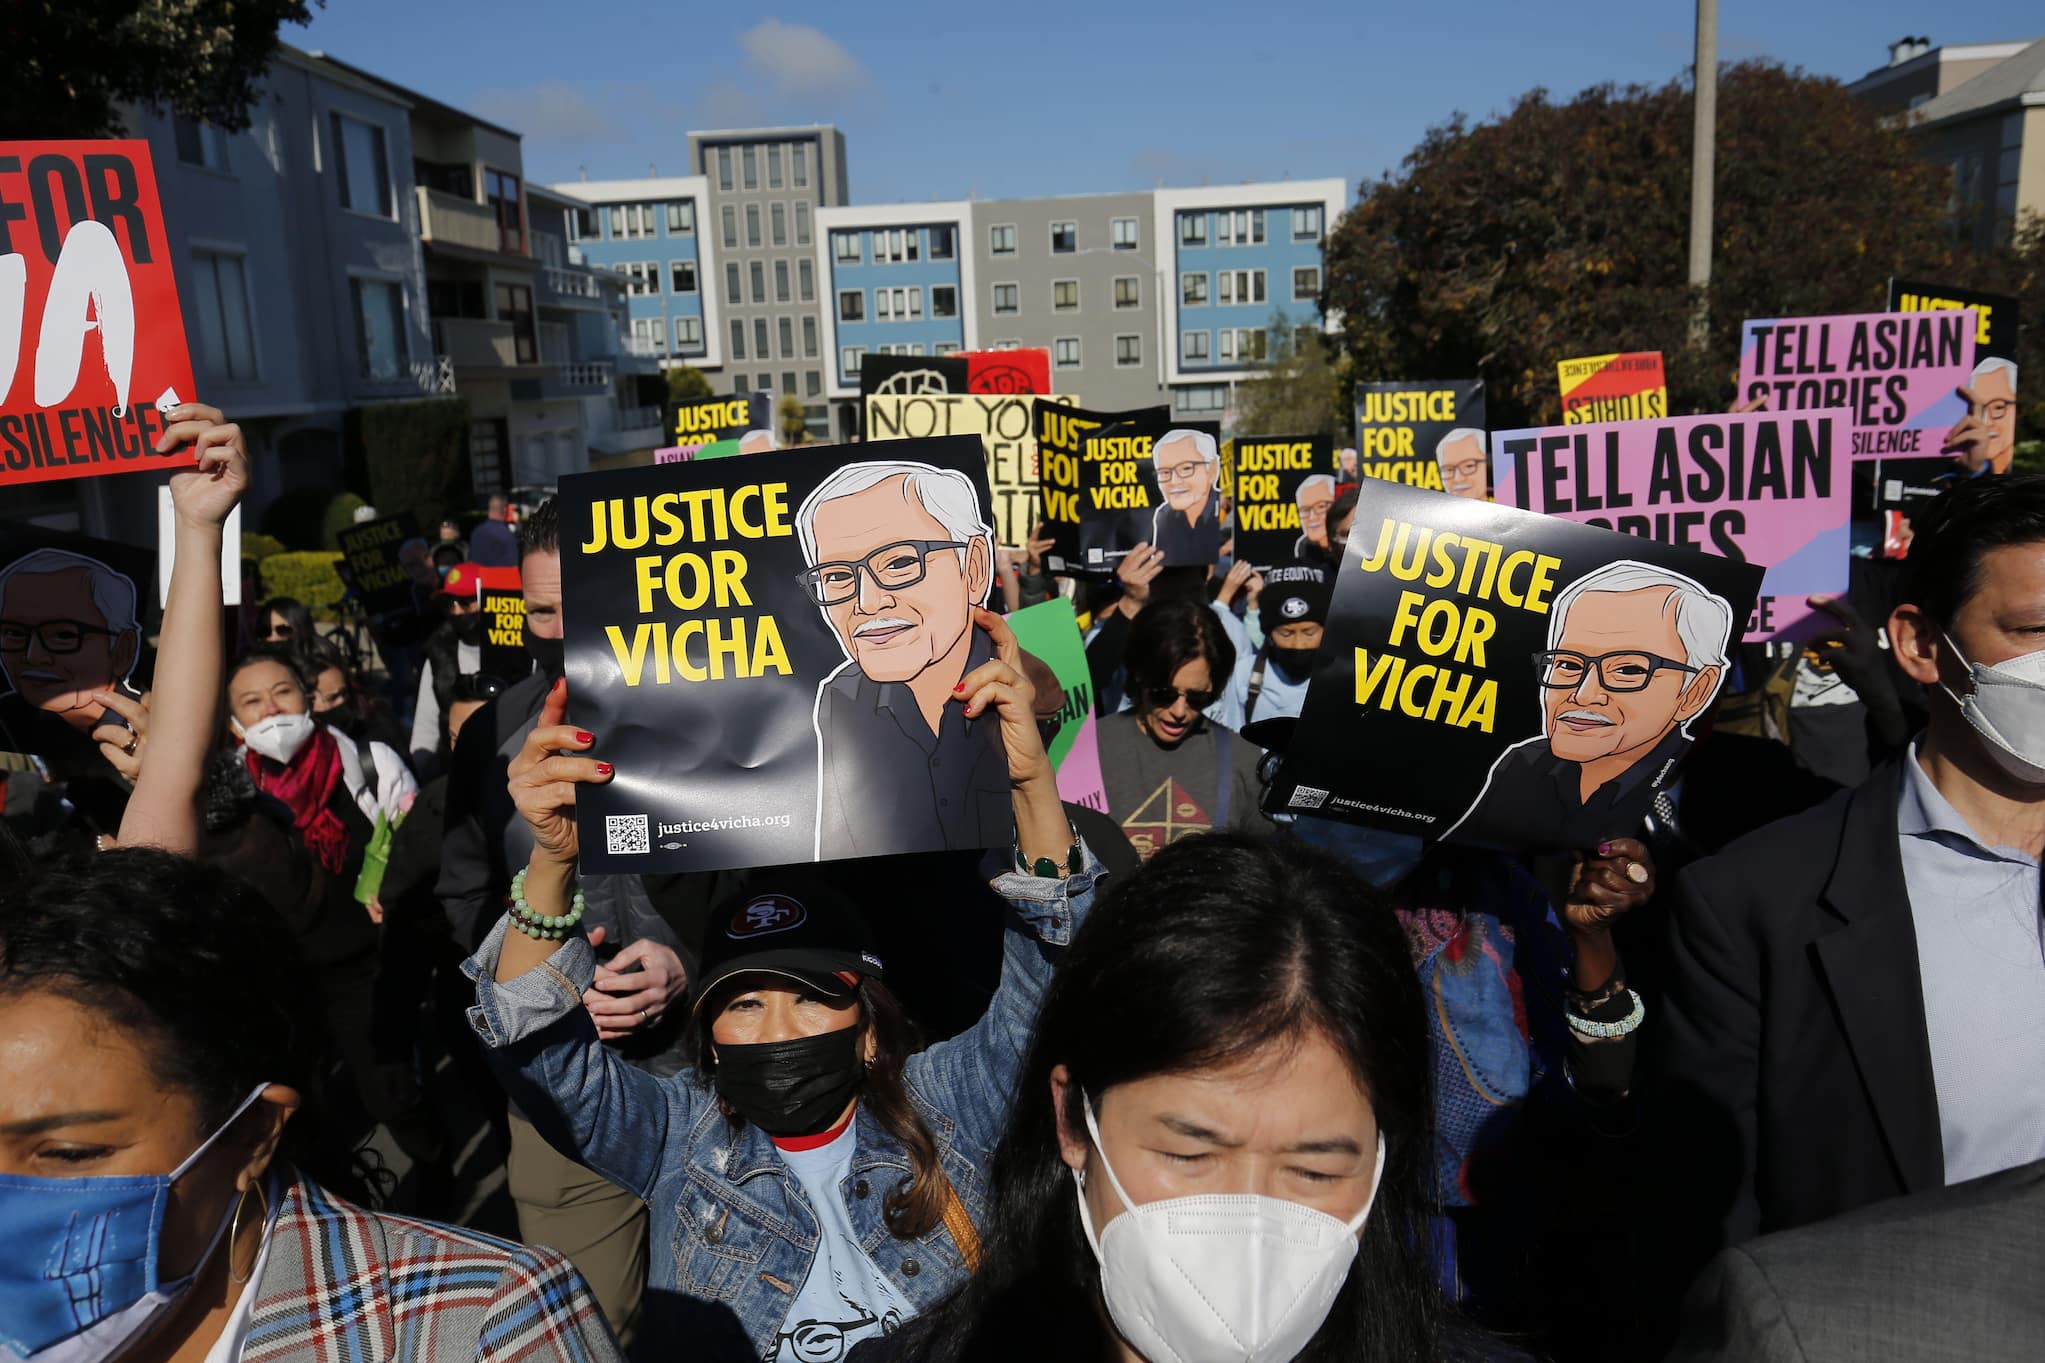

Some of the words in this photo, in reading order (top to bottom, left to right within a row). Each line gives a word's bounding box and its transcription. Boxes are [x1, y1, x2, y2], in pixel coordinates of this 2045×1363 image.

[1751, 323, 1836, 375] TELL
[1847, 316, 1963, 372] ASIAN
[675, 400, 750, 434] JUSTICE
[870, 398, 962, 438] NOT
[1361, 390, 1456, 424] JUSTICE
[1083, 436, 1153, 462] JUSTICE
[1237, 443, 1312, 472] JUSTICE
[1362, 426, 1414, 458] FOR
[1100, 461, 1138, 485] FOR
[1503, 431, 1633, 514] TELL
[1648, 418, 1832, 505] ASIAN
[1043, 486, 1080, 523] VIC
[1090, 485, 1149, 510] VICHA
[1239, 474, 1280, 502] FOR
[582, 483, 792, 554] JUSTICE
[1238, 502, 1301, 531] VICHA
[636, 550, 753, 614] FOR
[1361, 519, 1562, 615] JUSTICE
[484, 596, 527, 614] JUSTIC
[496, 613, 524, 630] FOR
[487, 628, 524, 647] VICH
[1388, 590, 1497, 668] FOR
[605, 616, 793, 687] VICHA
[1060, 683, 1089, 726] AN
[1354, 647, 1498, 734] VICHA
[657, 814, 791, 838] justice4vicha.org
[1330, 796, 1437, 824] justice4vicha.org
